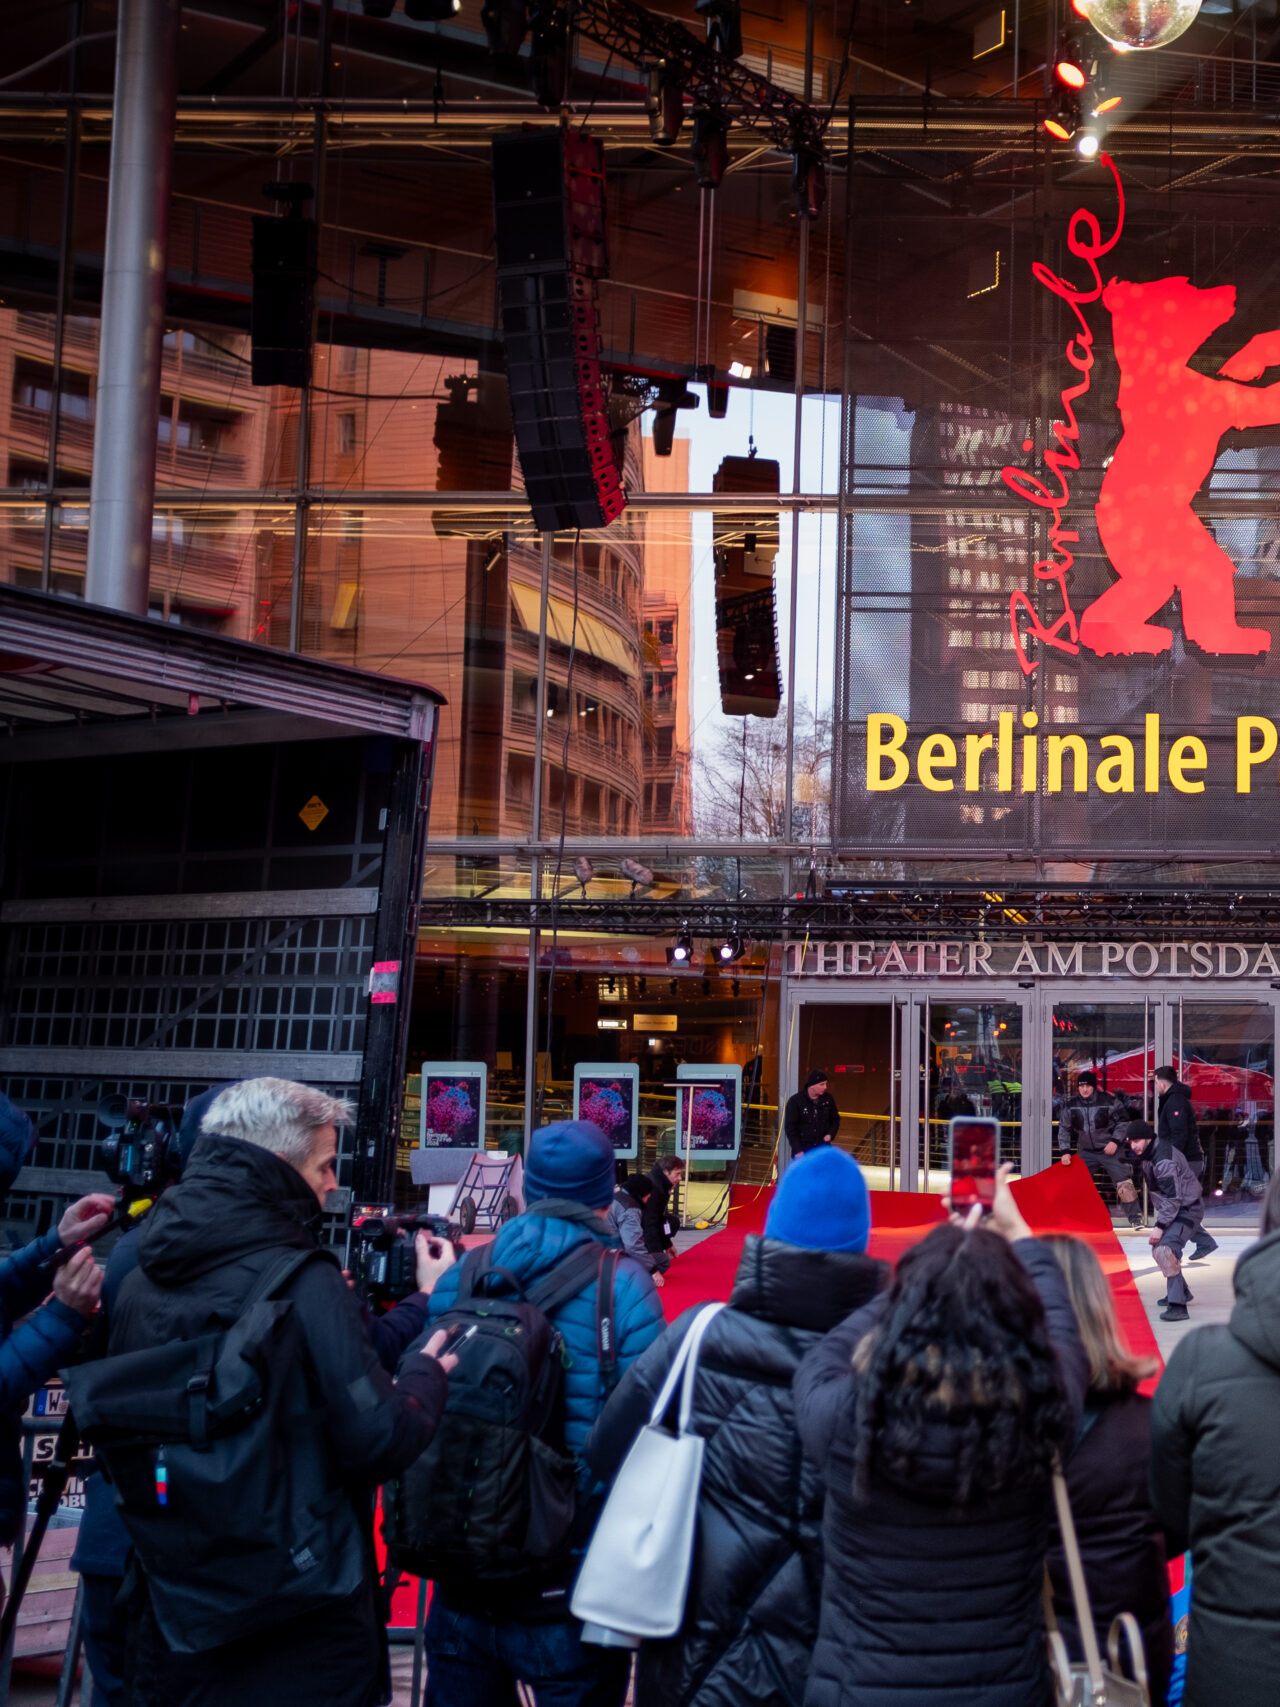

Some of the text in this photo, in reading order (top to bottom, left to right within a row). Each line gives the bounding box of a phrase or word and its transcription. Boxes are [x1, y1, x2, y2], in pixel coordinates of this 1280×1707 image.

[1001, 152, 1125, 676] Berlinale
[866, 711, 1208, 793] Berlinale
[784, 941, 998, 977] THEATER
[1011, 941, 1088, 977] AM
